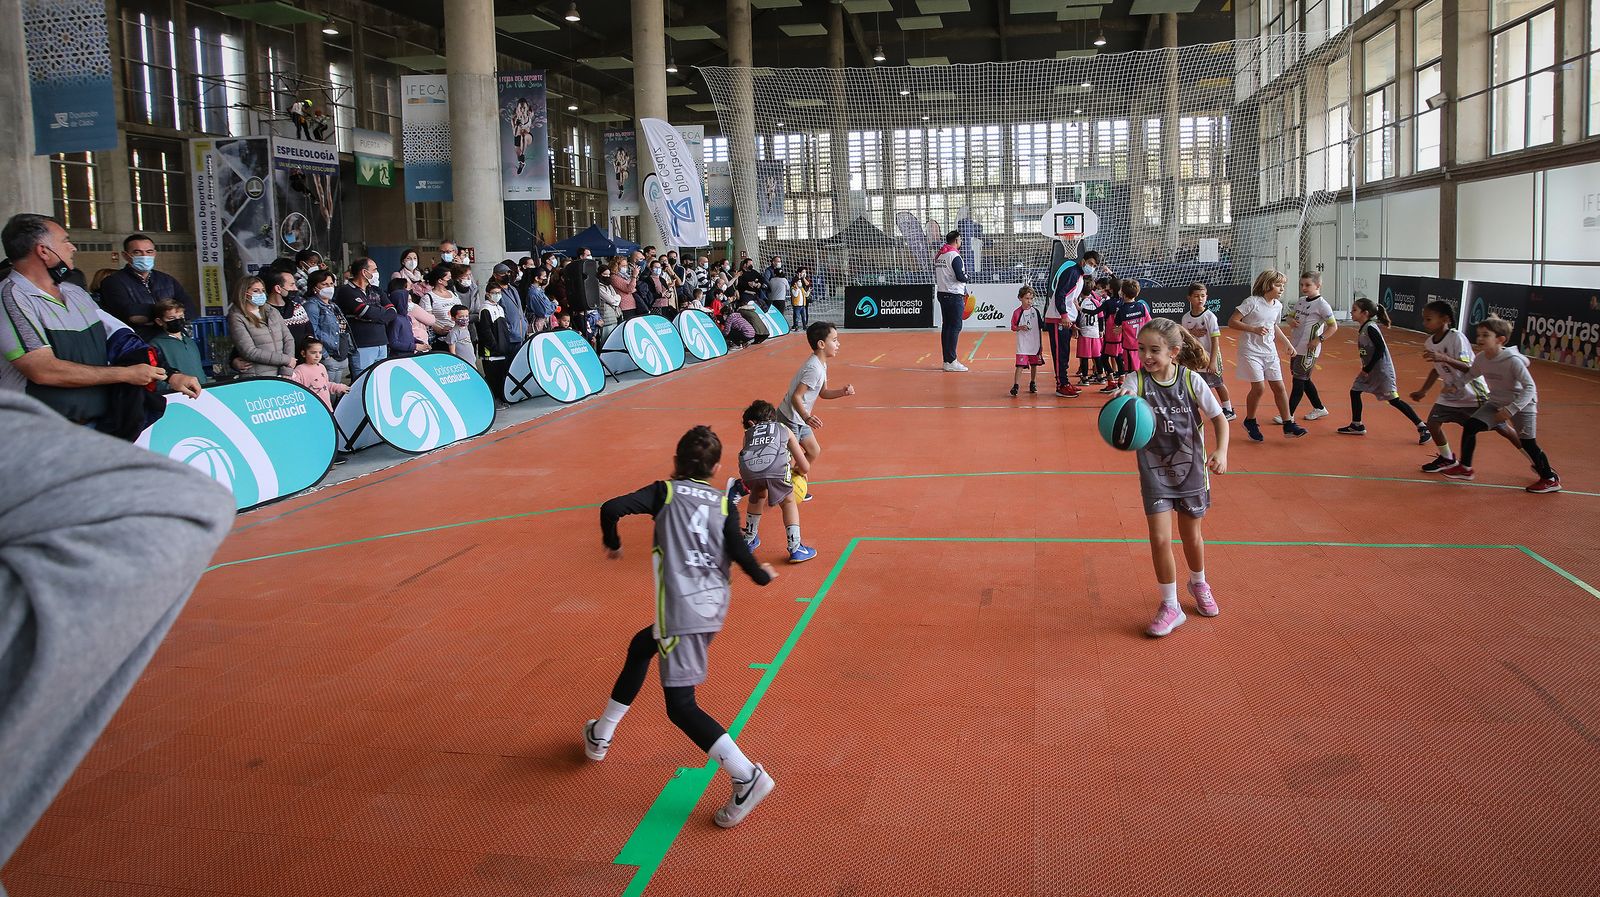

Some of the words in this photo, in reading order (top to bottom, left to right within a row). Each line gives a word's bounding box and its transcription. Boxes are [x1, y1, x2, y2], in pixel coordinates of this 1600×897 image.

[406, 84, 446, 96] IFECA
[276, 145, 335, 161] ESPELEOLOGÍA
[198, 175, 207, 218] Deportivo
[210, 215, 218, 249] Cañones
[211, 251, 219, 262] de
[881, 299, 923, 308] baloncesto
[1394, 291, 1415, 304] baloncesto
[880, 306, 921, 315] andalucía
[1152, 301, 1186, 309] baloncesto
[977, 311, 1005, 321] cesto
[1084, 315, 1096, 326] 10
[1132, 324, 1140, 339] 7
[1527, 315, 1600, 343] nosotras
[433, 362, 468, 377] baloncesto
[244, 390, 306, 413] baloncesto
[753, 422, 776, 438] 21
[1164, 420, 1175, 433] 16
[749, 436, 776, 447] JEREZ
[1157, 468, 1186, 478] UBJ
[676, 485, 719, 502] DKV
[687, 504, 710, 545] 4
